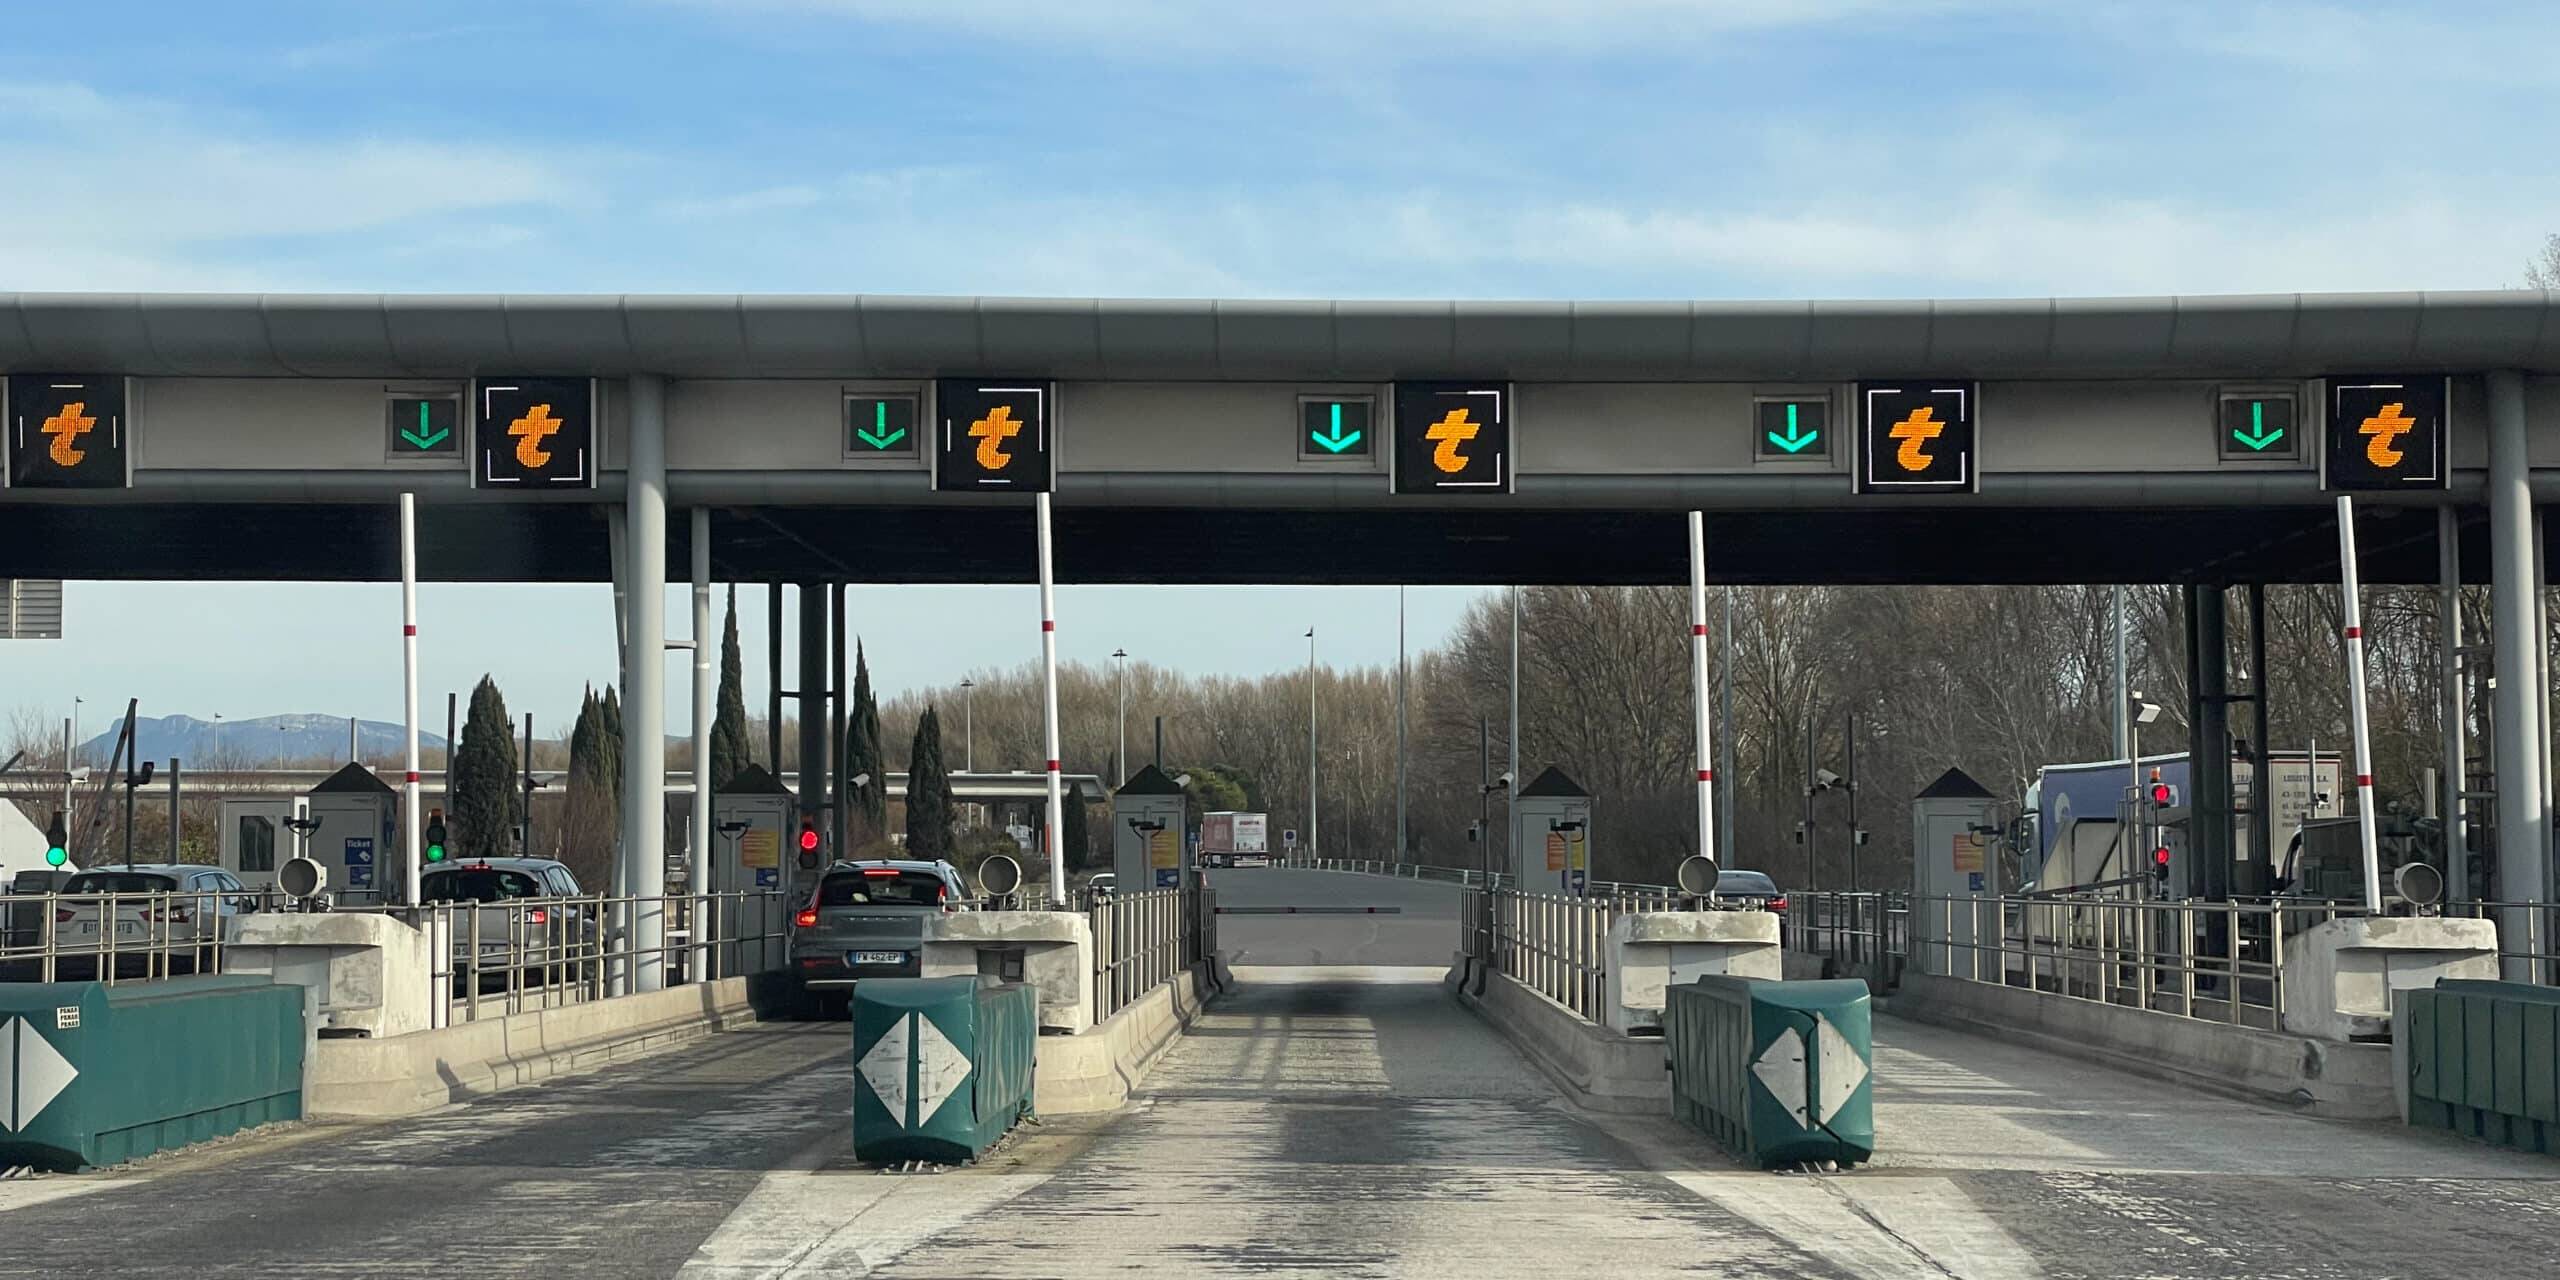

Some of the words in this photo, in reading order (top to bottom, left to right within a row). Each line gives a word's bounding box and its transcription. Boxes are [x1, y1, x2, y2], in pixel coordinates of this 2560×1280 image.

[41, 402, 96, 466] t
[508, 404, 562, 468] t
[969, 405, 1022, 470] t
[1425, 408, 1480, 473] t
[1889, 406, 1944, 471] t
[2359, 404, 2416, 468] t
[346, 839, 371, 848] Ticket
